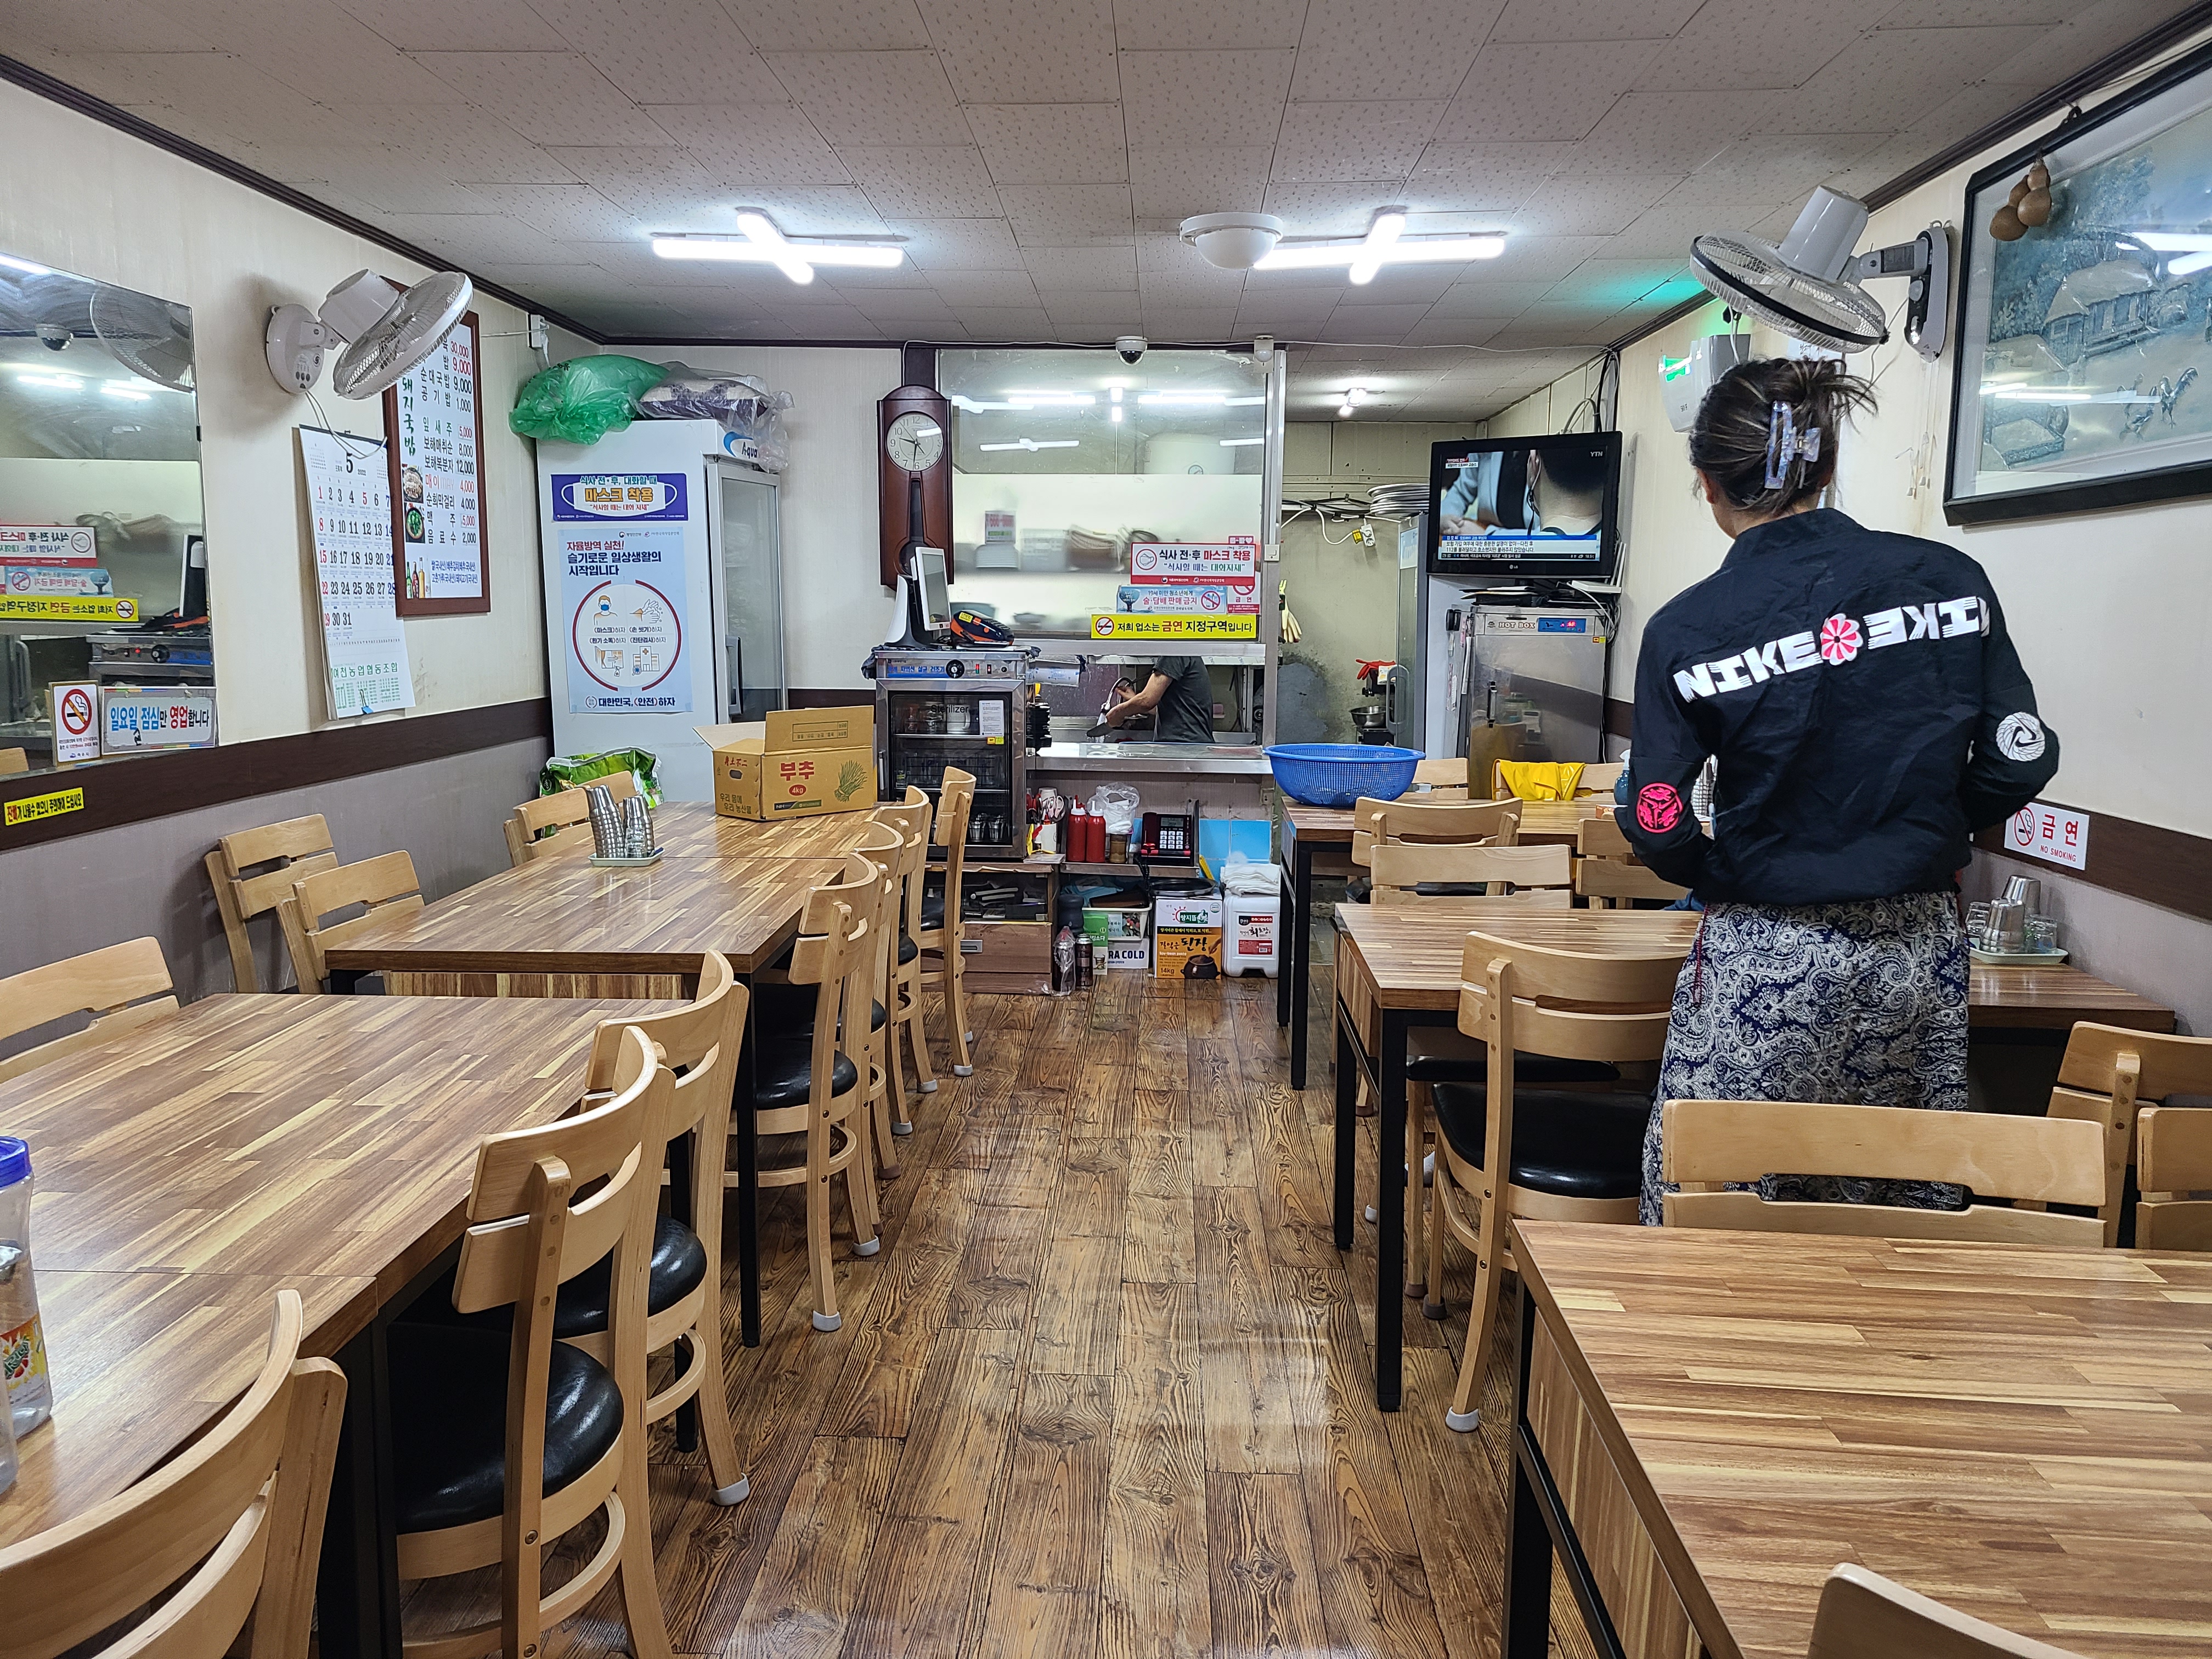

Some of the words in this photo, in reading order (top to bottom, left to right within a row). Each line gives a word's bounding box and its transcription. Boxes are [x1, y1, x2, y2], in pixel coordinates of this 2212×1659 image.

[450, 340, 469, 359] 30,000
[453, 358, 471, 376] 9,000
[454, 376, 472, 394] 9,000
[456, 398, 471, 413] 1,000
[912, 416, 921, 424] 12
[459, 426, 472, 439] 5,000
[894, 427, 902, 436] 10
[424, 436, 454, 456] 보해매취순
[459, 443, 473, 459] 8,000
[890, 439, 896, 447] 9
[346, 452, 353, 473] 5
[425, 454, 454, 474] 보해복분자
[456, 461, 475, 475] 12,000
[902, 459, 908, 467] 7
[925, 459, 931, 467] 5
[460, 479, 475, 494] 4,000
[580, 476, 596, 485] 식사
[624, 476, 647, 486] 대화할
[649, 476, 657, 485] 때
[318, 485, 323, 499] 1
[329, 487, 333, 501] 2
[338, 488, 342, 502] 3
[349, 490, 354, 504] 4
[363, 492, 367, 505] 5
[374, 493, 379, 506] 6
[385, 495, 390, 508] 7
[585, 488, 623, 503] 마스크
[628, 487, 654, 503] 착용
[426, 493, 455, 510] 순희막걸리
[461, 497, 476, 511] 4,000
[319, 517, 324, 532] 8
[330, 518, 334, 533] 9
[338, 520, 346, 534] 10
[349, 521, 359, 534] 11
[362, 522, 371, 535] 12
[374, 523, 382, 537] 13
[462, 515, 475, 527] 5,000
[462, 532, 477, 545] 2,000
[567, 541, 602, 551] 자율방역
[603, 540, 625, 550] 실천!
[319, 549, 327, 564] 15
[330, 550, 337, 564] 16
[340, 550, 348, 565] 17
[351, 551, 360, 565] 18
[364, 552, 373, 566] 19
[375, 552, 384, 566] 20
[567, 552, 608, 564] 슬기로운
[611, 551, 662, 563] 일상생활의
[1159, 549, 1177, 561] 식사
[1180, 549, 1201, 561] 전·후
[1203, 550, 1230, 561] 마스크
[1233, 550, 1251, 561] 착용
[569, 565, 620, 577] 시작입니다
[330, 581, 338, 595] 23
[341, 582, 351, 595] 24
[352, 582, 363, 595] 25
[365, 582, 375, 595] 26
[377, 582, 385, 595] 27
[1142, 596, 1166, 606] 술·담배
[1167, 596, 1182, 606] 판매
[1183, 596, 1197, 606] 금지
[332, 612, 340, 626] 30
[342, 612, 352, 626] 31
[1117, 622, 1133, 632] 저희
[1136, 622, 1160, 632] 업소는
[1161, 620, 1183, 633] 금연
[1186, 620, 1252, 633] 지정구역입니다
[1673, 630, 1824, 703] NIKE
[930, 704, 969, 714] Sterilizer
[110, 706, 137, 731] 일요일
[140, 706, 167, 730] 점심만
[170, 705, 210, 730] 영업합니다
[724, 755, 748, 767] 身土不二
[780, 761, 815, 781] 부추
[792, 786, 804, 794] 4kg
[720, 793, 730, 802] 우리
[731, 794, 742, 804] 몸에
[724, 803, 735, 812] 우리
[736, 805, 752, 815] 농산물
[2040, 845, 2049, 854] NO
[2050, 848, 2076, 862] SMOKING
[1181, 936, 1207, 952] 된장
[1122, 950, 1145, 959] COLD
